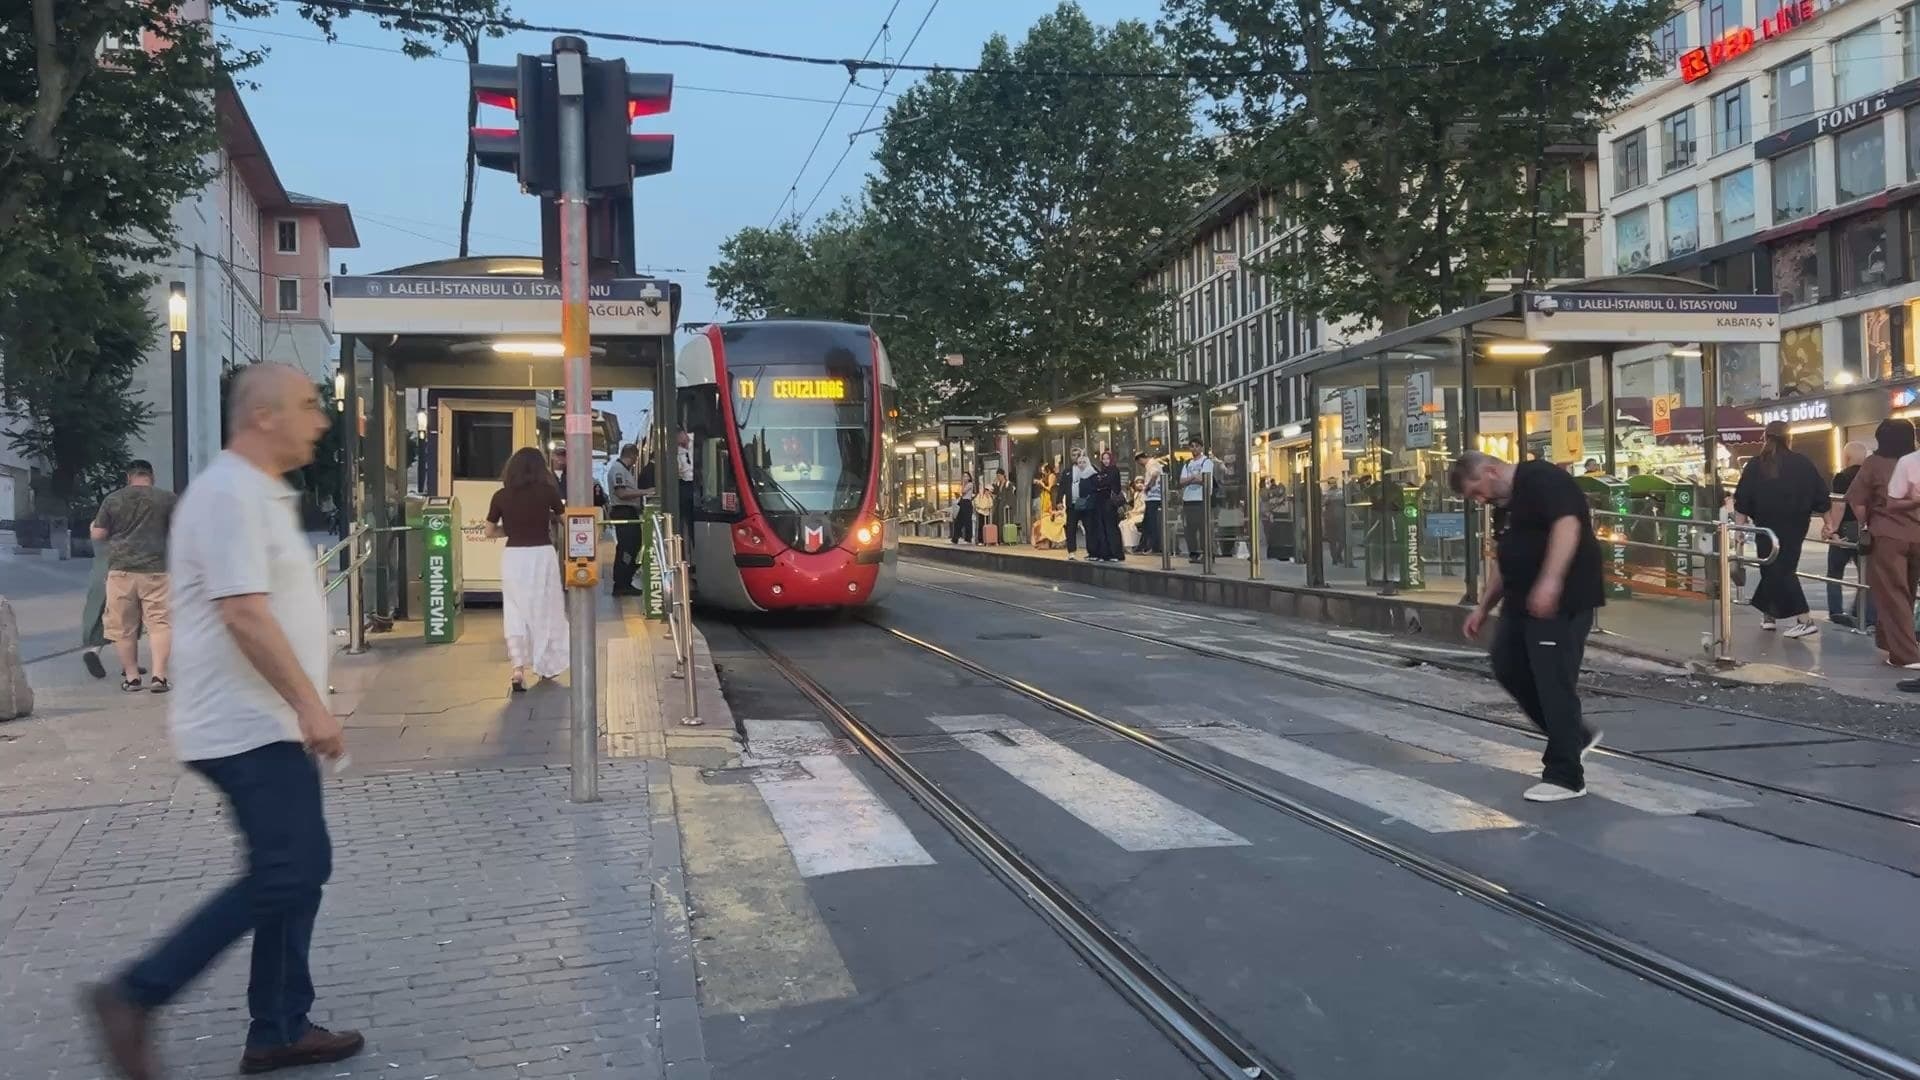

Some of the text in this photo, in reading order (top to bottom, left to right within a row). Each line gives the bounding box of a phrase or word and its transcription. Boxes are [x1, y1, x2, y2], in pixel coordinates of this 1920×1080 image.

[1762, 0, 1814, 41] LINE
[389, 281, 509, 295] LALELİ-İSTANBUL
[512, 281, 527, 295] Ü.
[531, 281, 611, 296] İSTANU
[587, 303, 645, 316] AĞCILAR
[1578, 297, 1664, 309] LALELİ-İSTANBUL
[1666, 299, 1677, 309] Ü.
[1680, 298, 1737, 310] İSTASYONU
[1717, 318, 1762, 328] KABATAŞ
[740, 380, 755, 399] T1
[1791, 401, 1827, 422] DÖVİZ
[430, 555, 448, 636] EMİNEVİM
